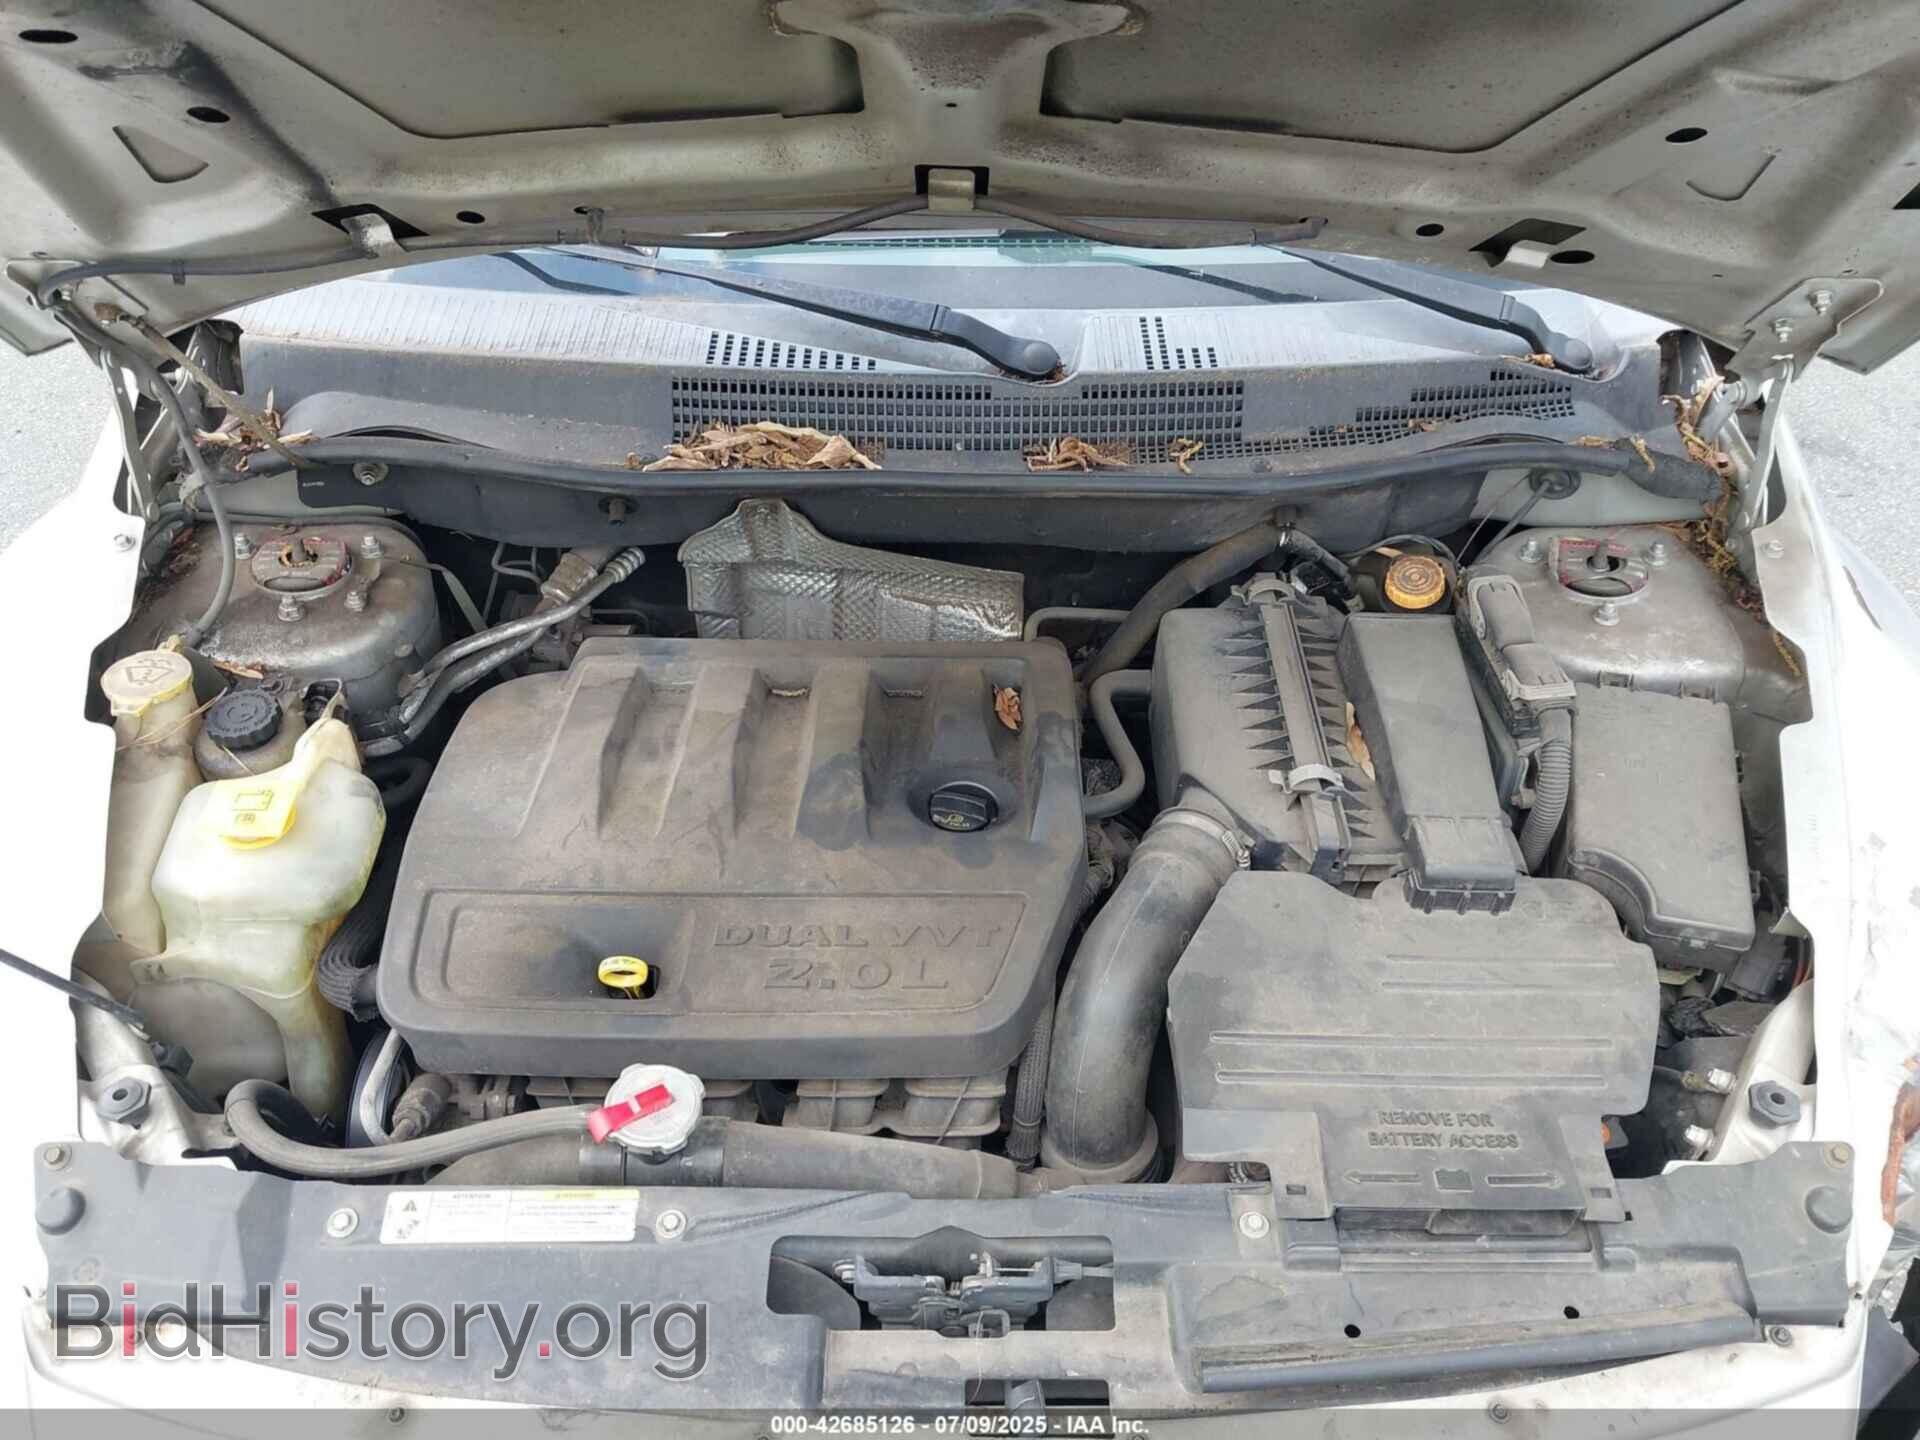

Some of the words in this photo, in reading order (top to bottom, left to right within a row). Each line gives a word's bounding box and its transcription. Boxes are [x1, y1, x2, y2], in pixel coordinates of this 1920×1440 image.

[714, 924, 870, 948] DUAL
[889, 925, 1003, 948] VVT
[764, 958, 949, 990] 2.0L
[1379, 1111, 1453, 1127] REMOVE
[1458, 1113, 1495, 1128] FOR
[1369, 1132, 1442, 1148] BATTERY
[1449, 1135, 1519, 1150] ACCESS
